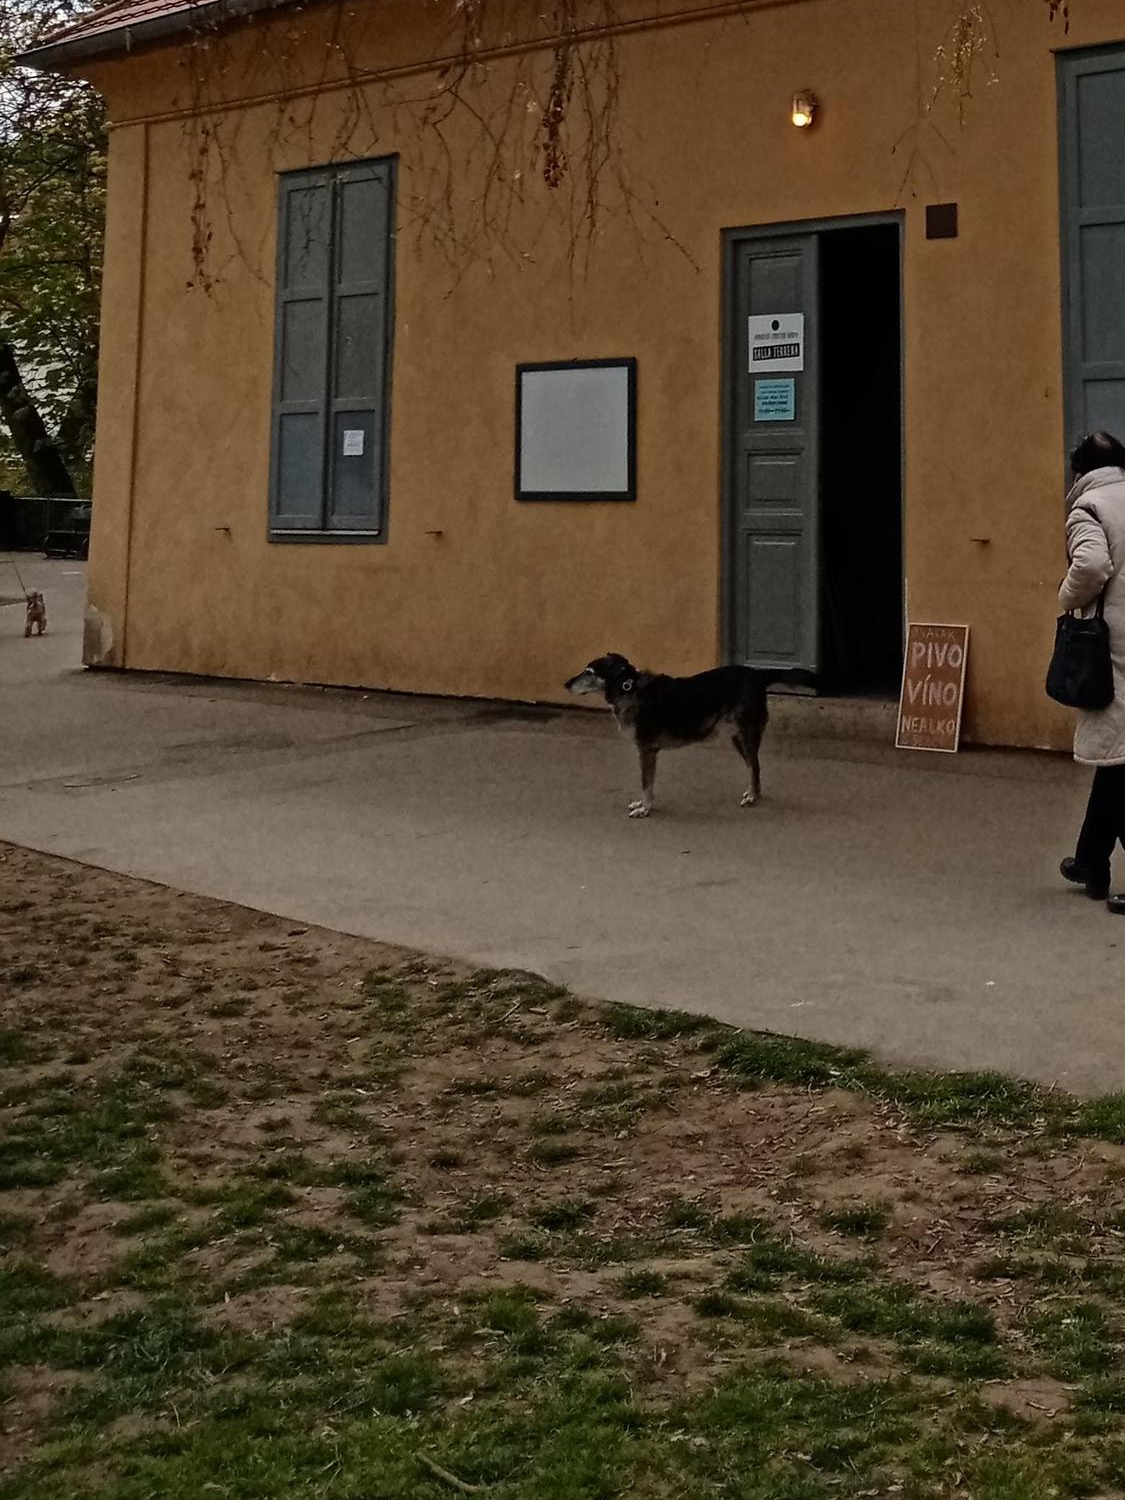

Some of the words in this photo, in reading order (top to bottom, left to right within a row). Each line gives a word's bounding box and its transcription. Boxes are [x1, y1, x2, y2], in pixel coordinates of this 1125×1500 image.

[912, 642, 962, 668] PIVO
[907, 674, 957, 706] VÍNO
[902, 716, 955, 734] NEALKO
